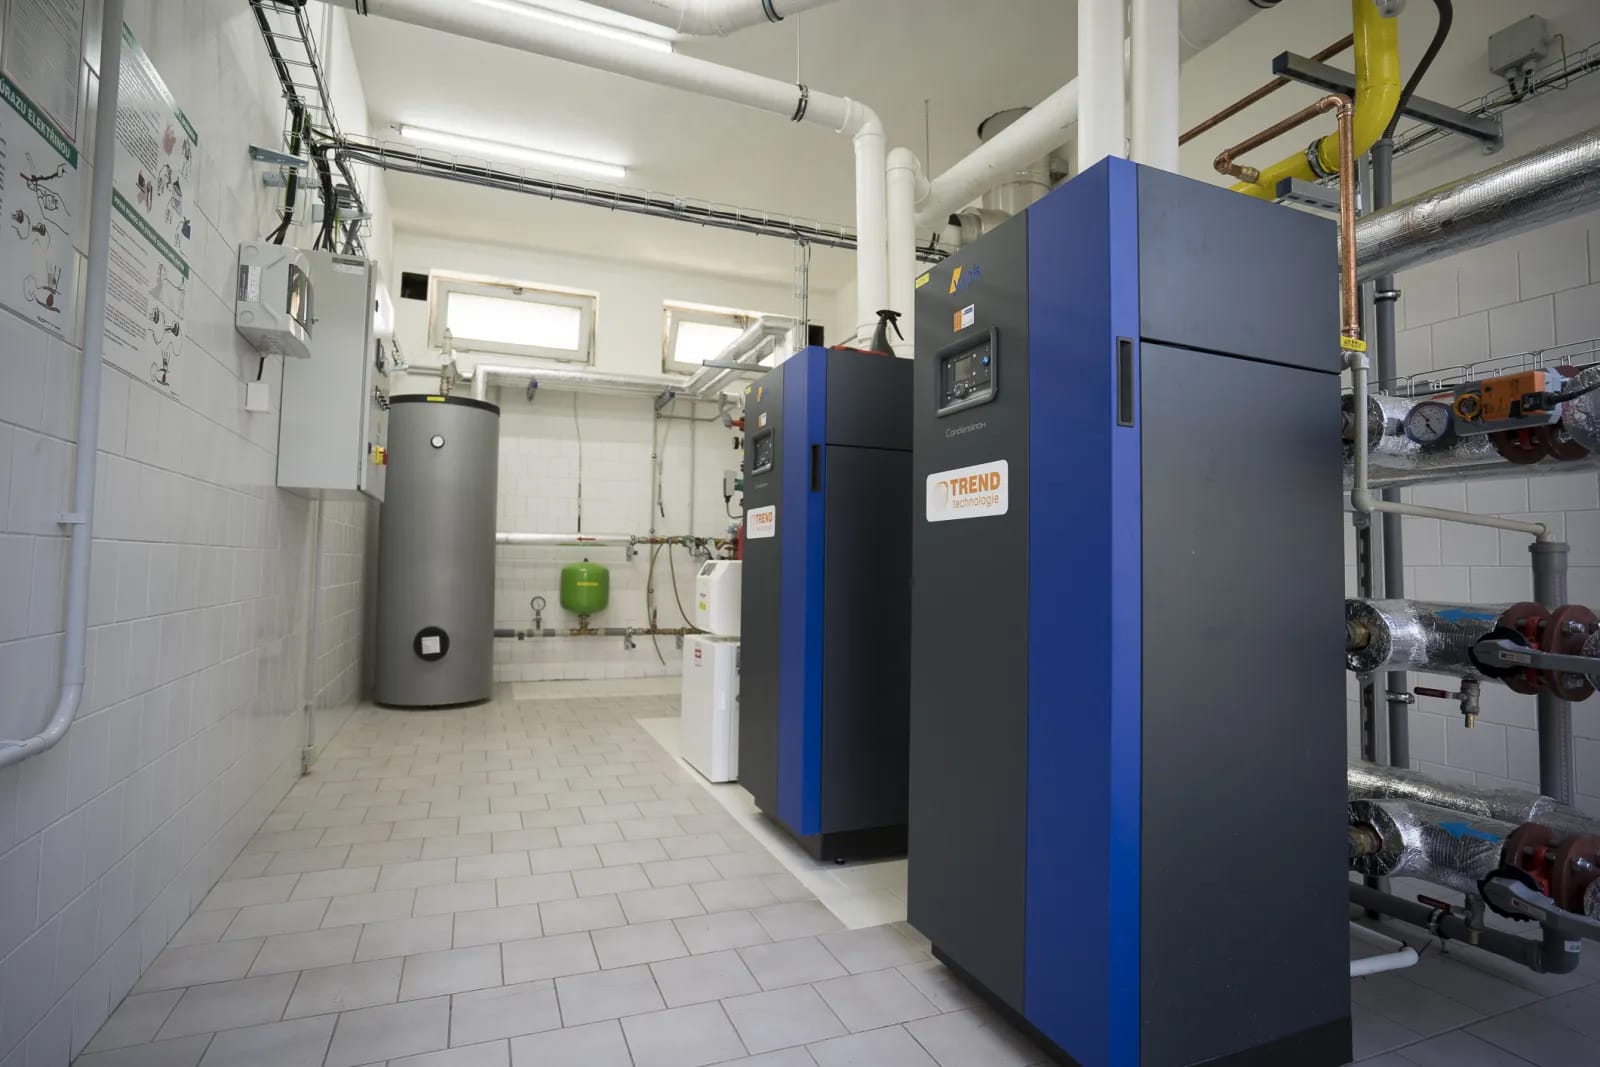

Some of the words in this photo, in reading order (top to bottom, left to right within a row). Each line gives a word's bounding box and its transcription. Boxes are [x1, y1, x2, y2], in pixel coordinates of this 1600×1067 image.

[27, 109, 71, 158] ELEKTŘINOU
[950, 471, 1001, 496] TREND
[952, 494, 1000, 509] technologie
